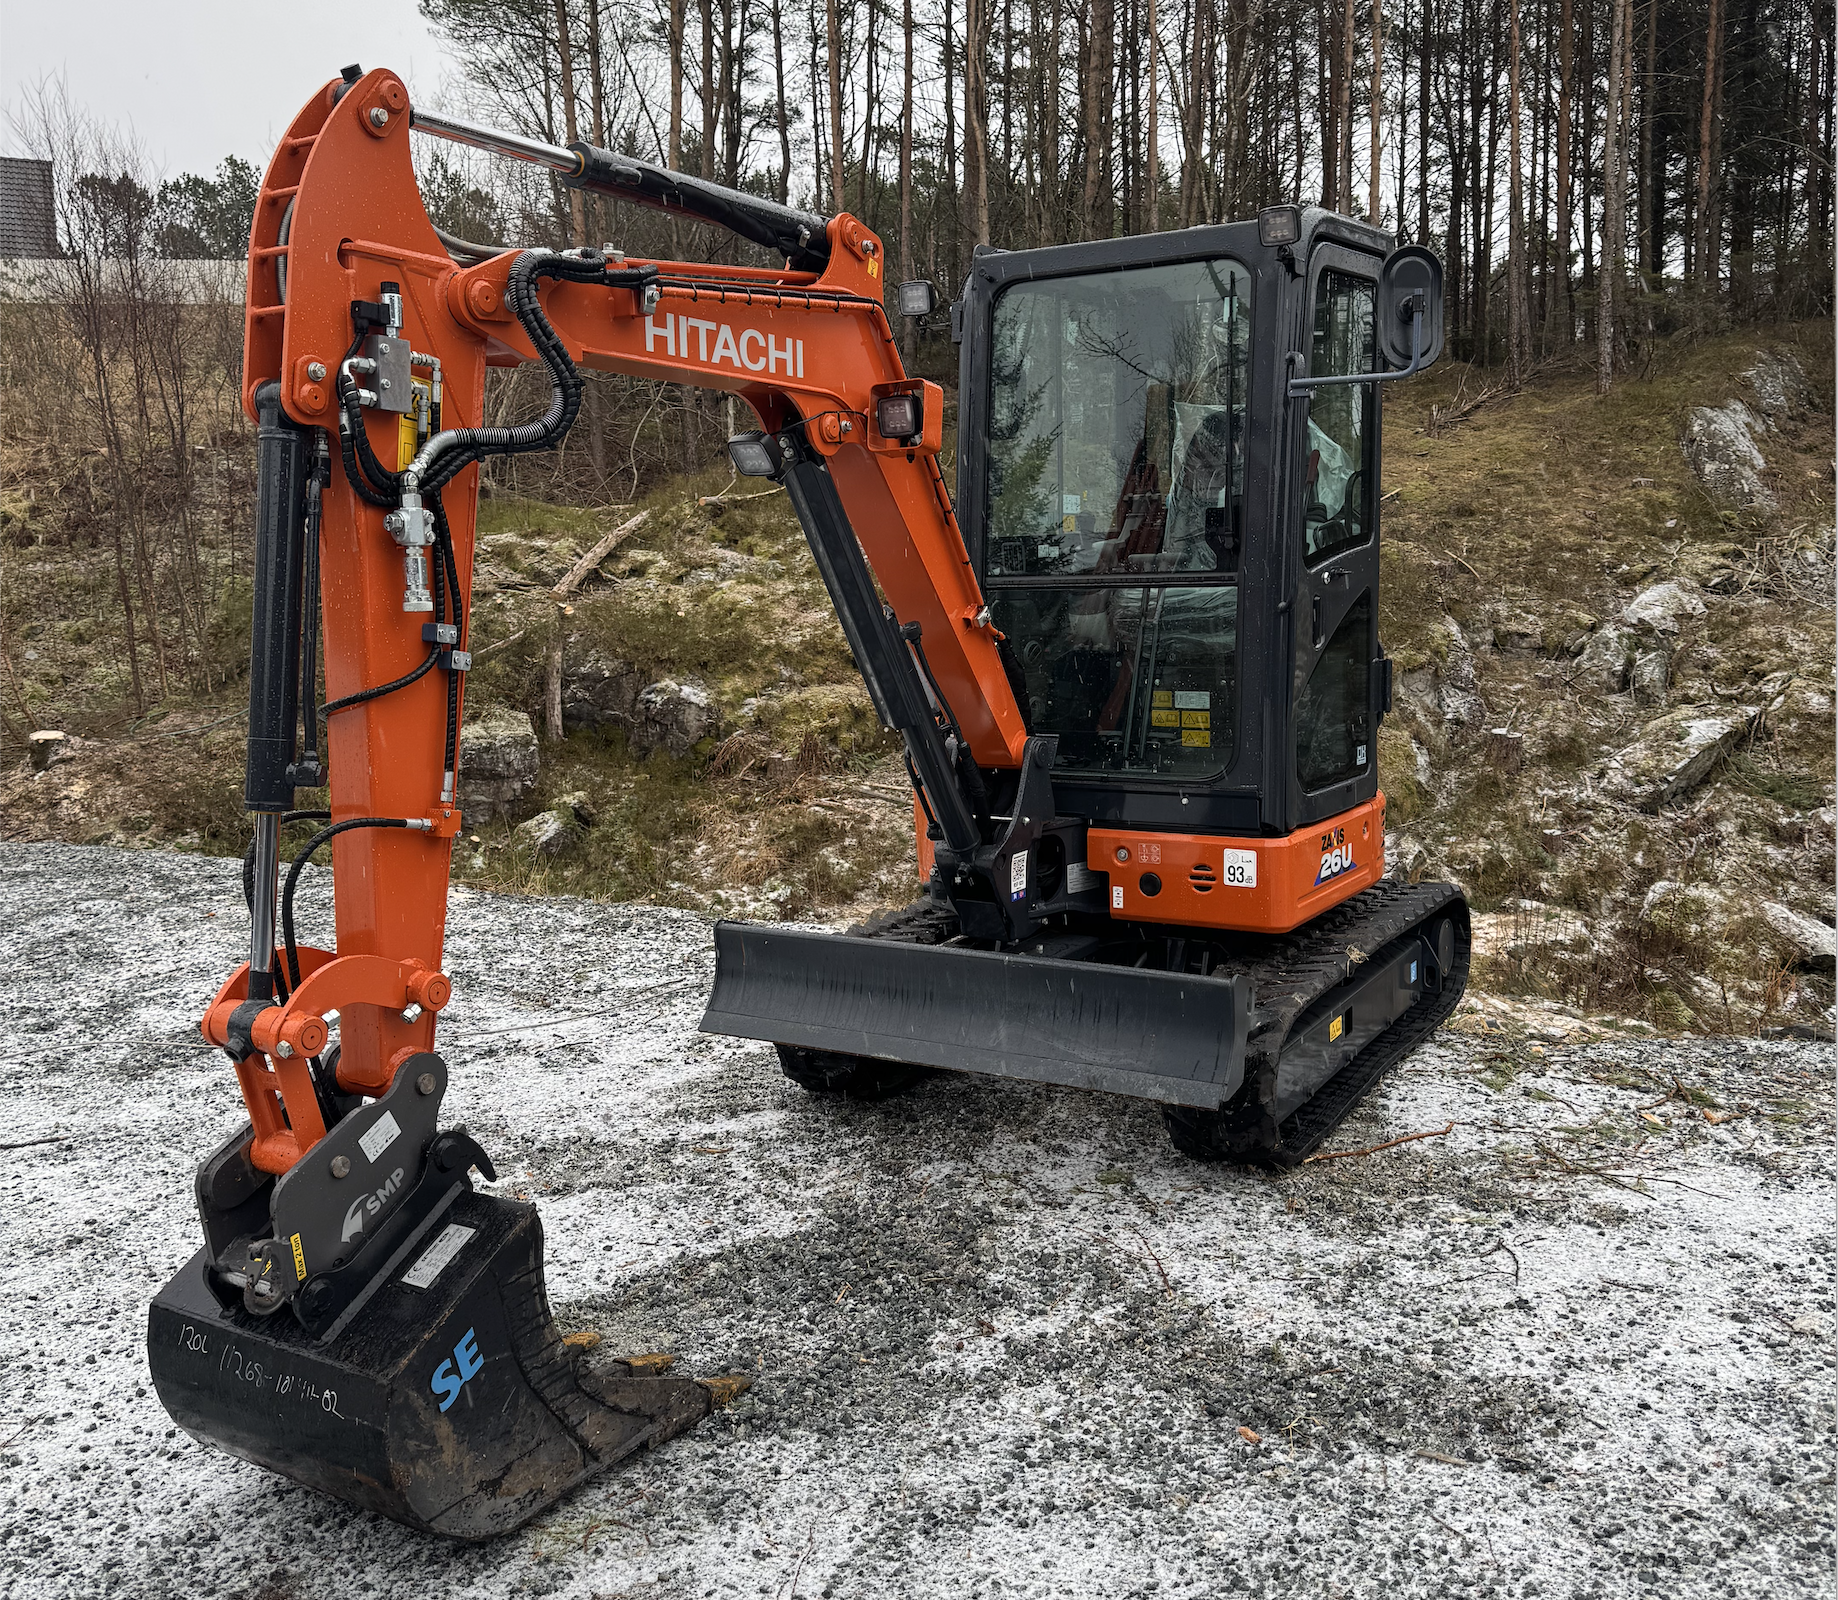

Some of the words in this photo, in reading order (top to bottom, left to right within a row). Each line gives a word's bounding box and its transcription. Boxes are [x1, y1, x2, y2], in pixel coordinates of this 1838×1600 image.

[645, 313, 804, 379] HITACHI
[1227, 865, 1245, 884] 93
[1245, 875, 1254, 884] dB
[1320, 843, 1353, 881] 26U
[366, 1167, 405, 1216] SMP
[295, 1251, 301, 1259] 2
[407, 1265, 422, 1279] CE
[431, 1327, 485, 1413] SE
